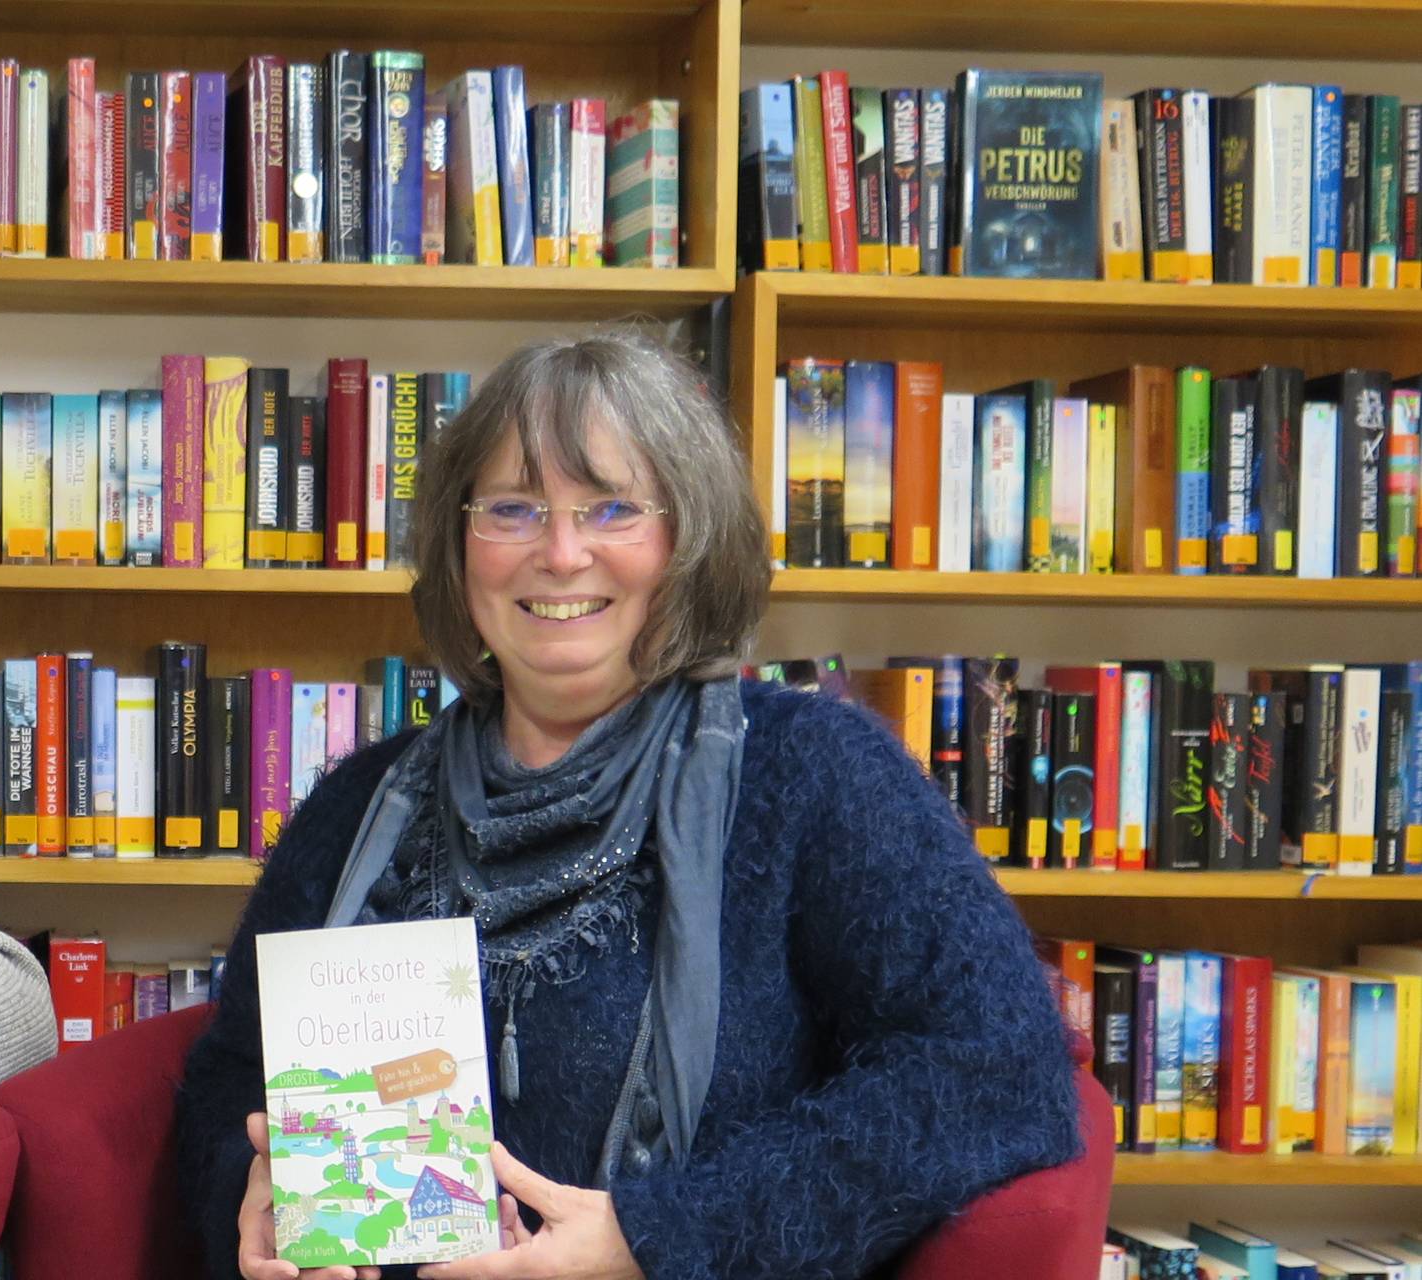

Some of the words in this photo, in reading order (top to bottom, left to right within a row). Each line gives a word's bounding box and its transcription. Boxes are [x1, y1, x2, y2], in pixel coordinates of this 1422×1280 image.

[267, 66, 284, 168] KAFFEEDIEB
[828, 85, 847, 129] Sohn
[1154, 98, 1179, 120] 16
[174, 113, 190, 154] ALICE
[832, 132, 848, 164] und
[893, 99, 916, 164] VANITAS
[923, 101, 945, 166] VANITAS
[1020, 126, 1046, 146] DIE
[1291, 112, 1305, 169] PETER
[1344, 121, 1361, 178] Krabat
[979, 148, 1083, 183] PETRUS
[1155, 122, 1169, 200] PATTERSON
[834, 169, 851, 214] Vater
[1157, 200, 1171, 243] JAMES
[1290, 175, 1305, 249] PRANGE
[263, 391, 276, 415] BOTE
[391, 371, 418, 459] GERÜCHT
[108, 414, 117, 441] ELLEN
[141, 411, 150, 437] ELLEN
[263, 418, 276, 436] DER
[108, 442, 119, 474] JACOBI
[140, 439, 150, 471] JACOBI
[258, 446, 279, 527] JOHNSRUD
[297, 465, 315, 533] JOHNSRUD
[393, 463, 417, 500] DAS
[137, 488, 146, 542] JUBILÄUM
[410, 679, 436, 688] LAUB
[170, 691, 180, 728] Kutscher
[183, 688, 197, 757] OLYMPIA
[10, 727, 22, 742] IM
[10, 745, 22, 778] TOTE
[21, 727, 33, 791] WANNSEE
[10, 780, 22, 802] DIE
[46, 746, 58, 817] ONSCHAU
[74, 759, 88, 817] Eurotrash
[987, 775, 997, 814] FRANK
[58, 952, 99, 961] Charlotte
[69, 961, 89, 971] Link
[309, 956, 427, 989] Glücksorte
[349, 990, 362, 1004] in
[365, 989, 386, 1003] der
[1243, 986, 1257, 1036] SPARKS
[296, 1012, 447, 1049] Oberlausitz
[278, 1072, 320, 1087] DROSTE
[412, 1061, 422, 1074] &
[1243, 1036, 1258, 1102] NICHOLAS
[289, 1246, 311, 1260] Antje
[312, 1245, 336, 1258] Kluth
